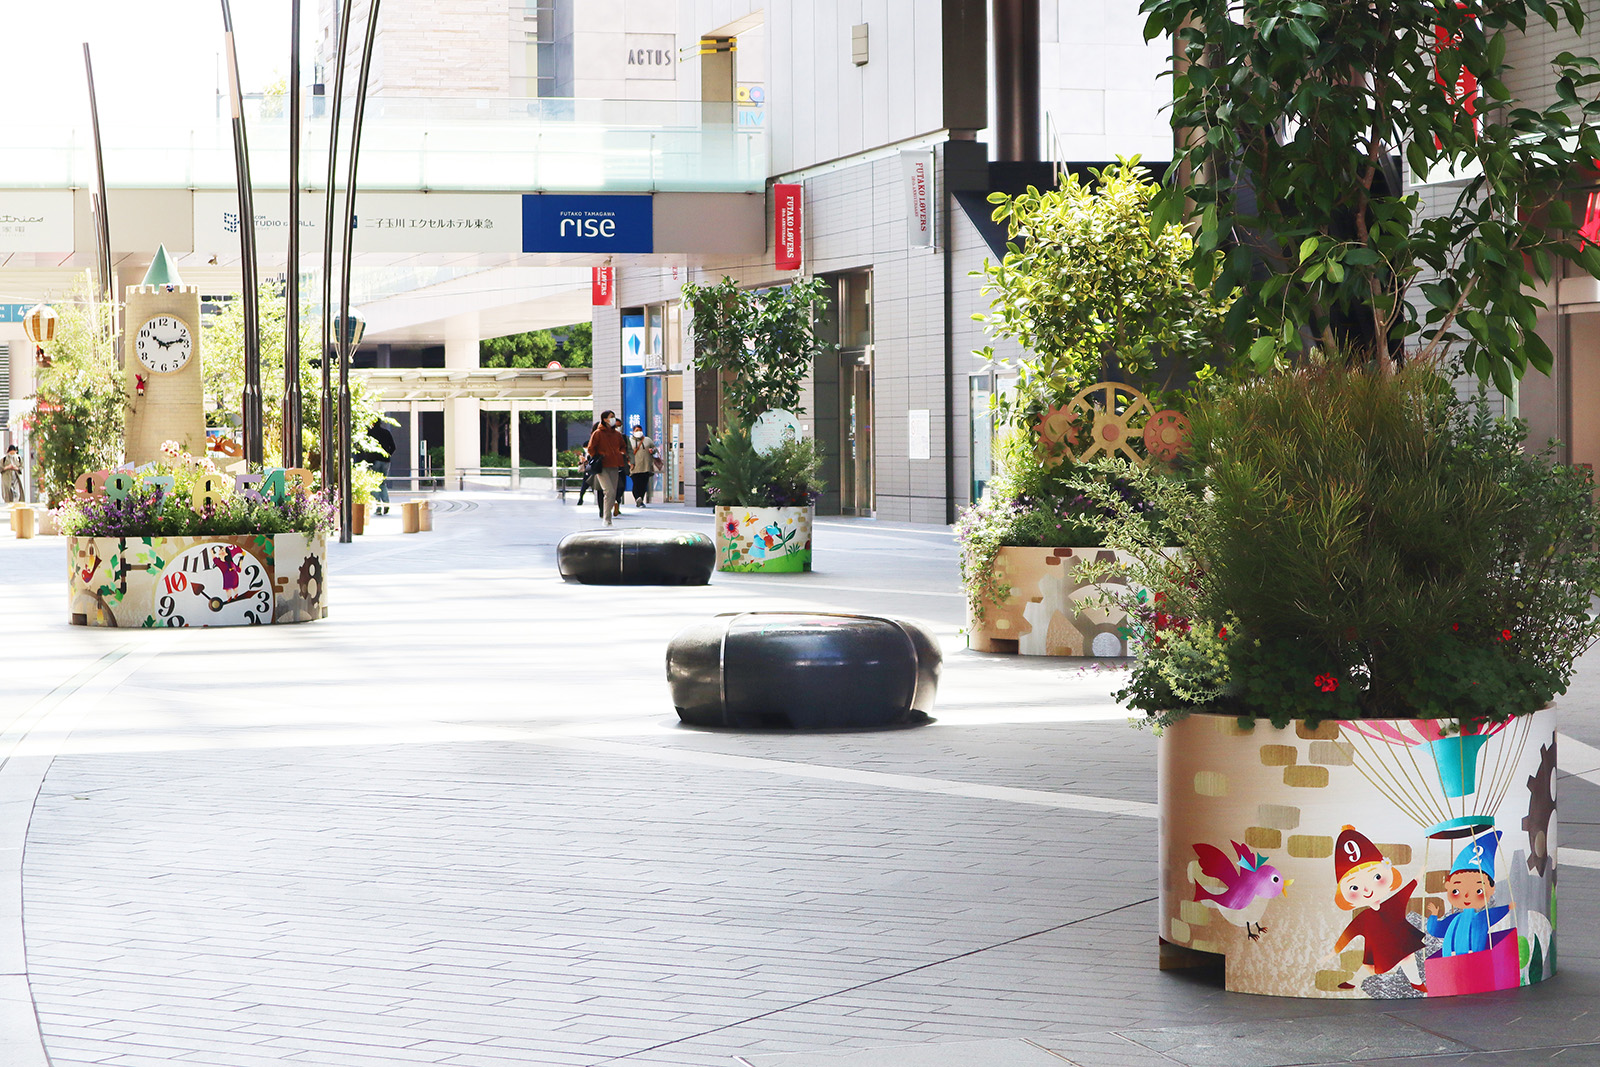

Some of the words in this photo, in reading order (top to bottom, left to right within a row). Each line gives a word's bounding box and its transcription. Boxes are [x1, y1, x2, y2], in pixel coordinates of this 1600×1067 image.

[628, 49, 671, 65] ACTUS
[915, 162, 926, 196] FUTAKO
[365, 218, 405, 228] 二子玉川
[408, 218, 494, 229] エクセルホテル東急
[560, 218, 616, 237] rise
[149, 321, 156, 329] 11
[159, 318, 168, 326] 12
[173, 321, 177, 329] 1
[140, 329, 150, 337] 10
[180, 329, 187, 337] 2
[138, 341, 145, 349] 9
[183, 340, 190, 348] 3
[141, 352, 148, 360] 8
[150, 360, 156, 369] 7
[172, 360, 179, 369] 5
[160, 363, 168, 371] 6
[142, 475, 176, 516] 7
[191, 474, 223, 517] 6
[234, 473, 264, 505] 5
[260, 469, 292, 507] 4
[181, 555, 199, 573] 11
[162, 571, 188, 595] 10
[244, 564, 264, 590] 2
[157, 595, 175, 617] 9
[256, 590, 270, 613] 3
[1343, 840, 1362, 863] 9
[1468, 845, 1484, 865] 2
